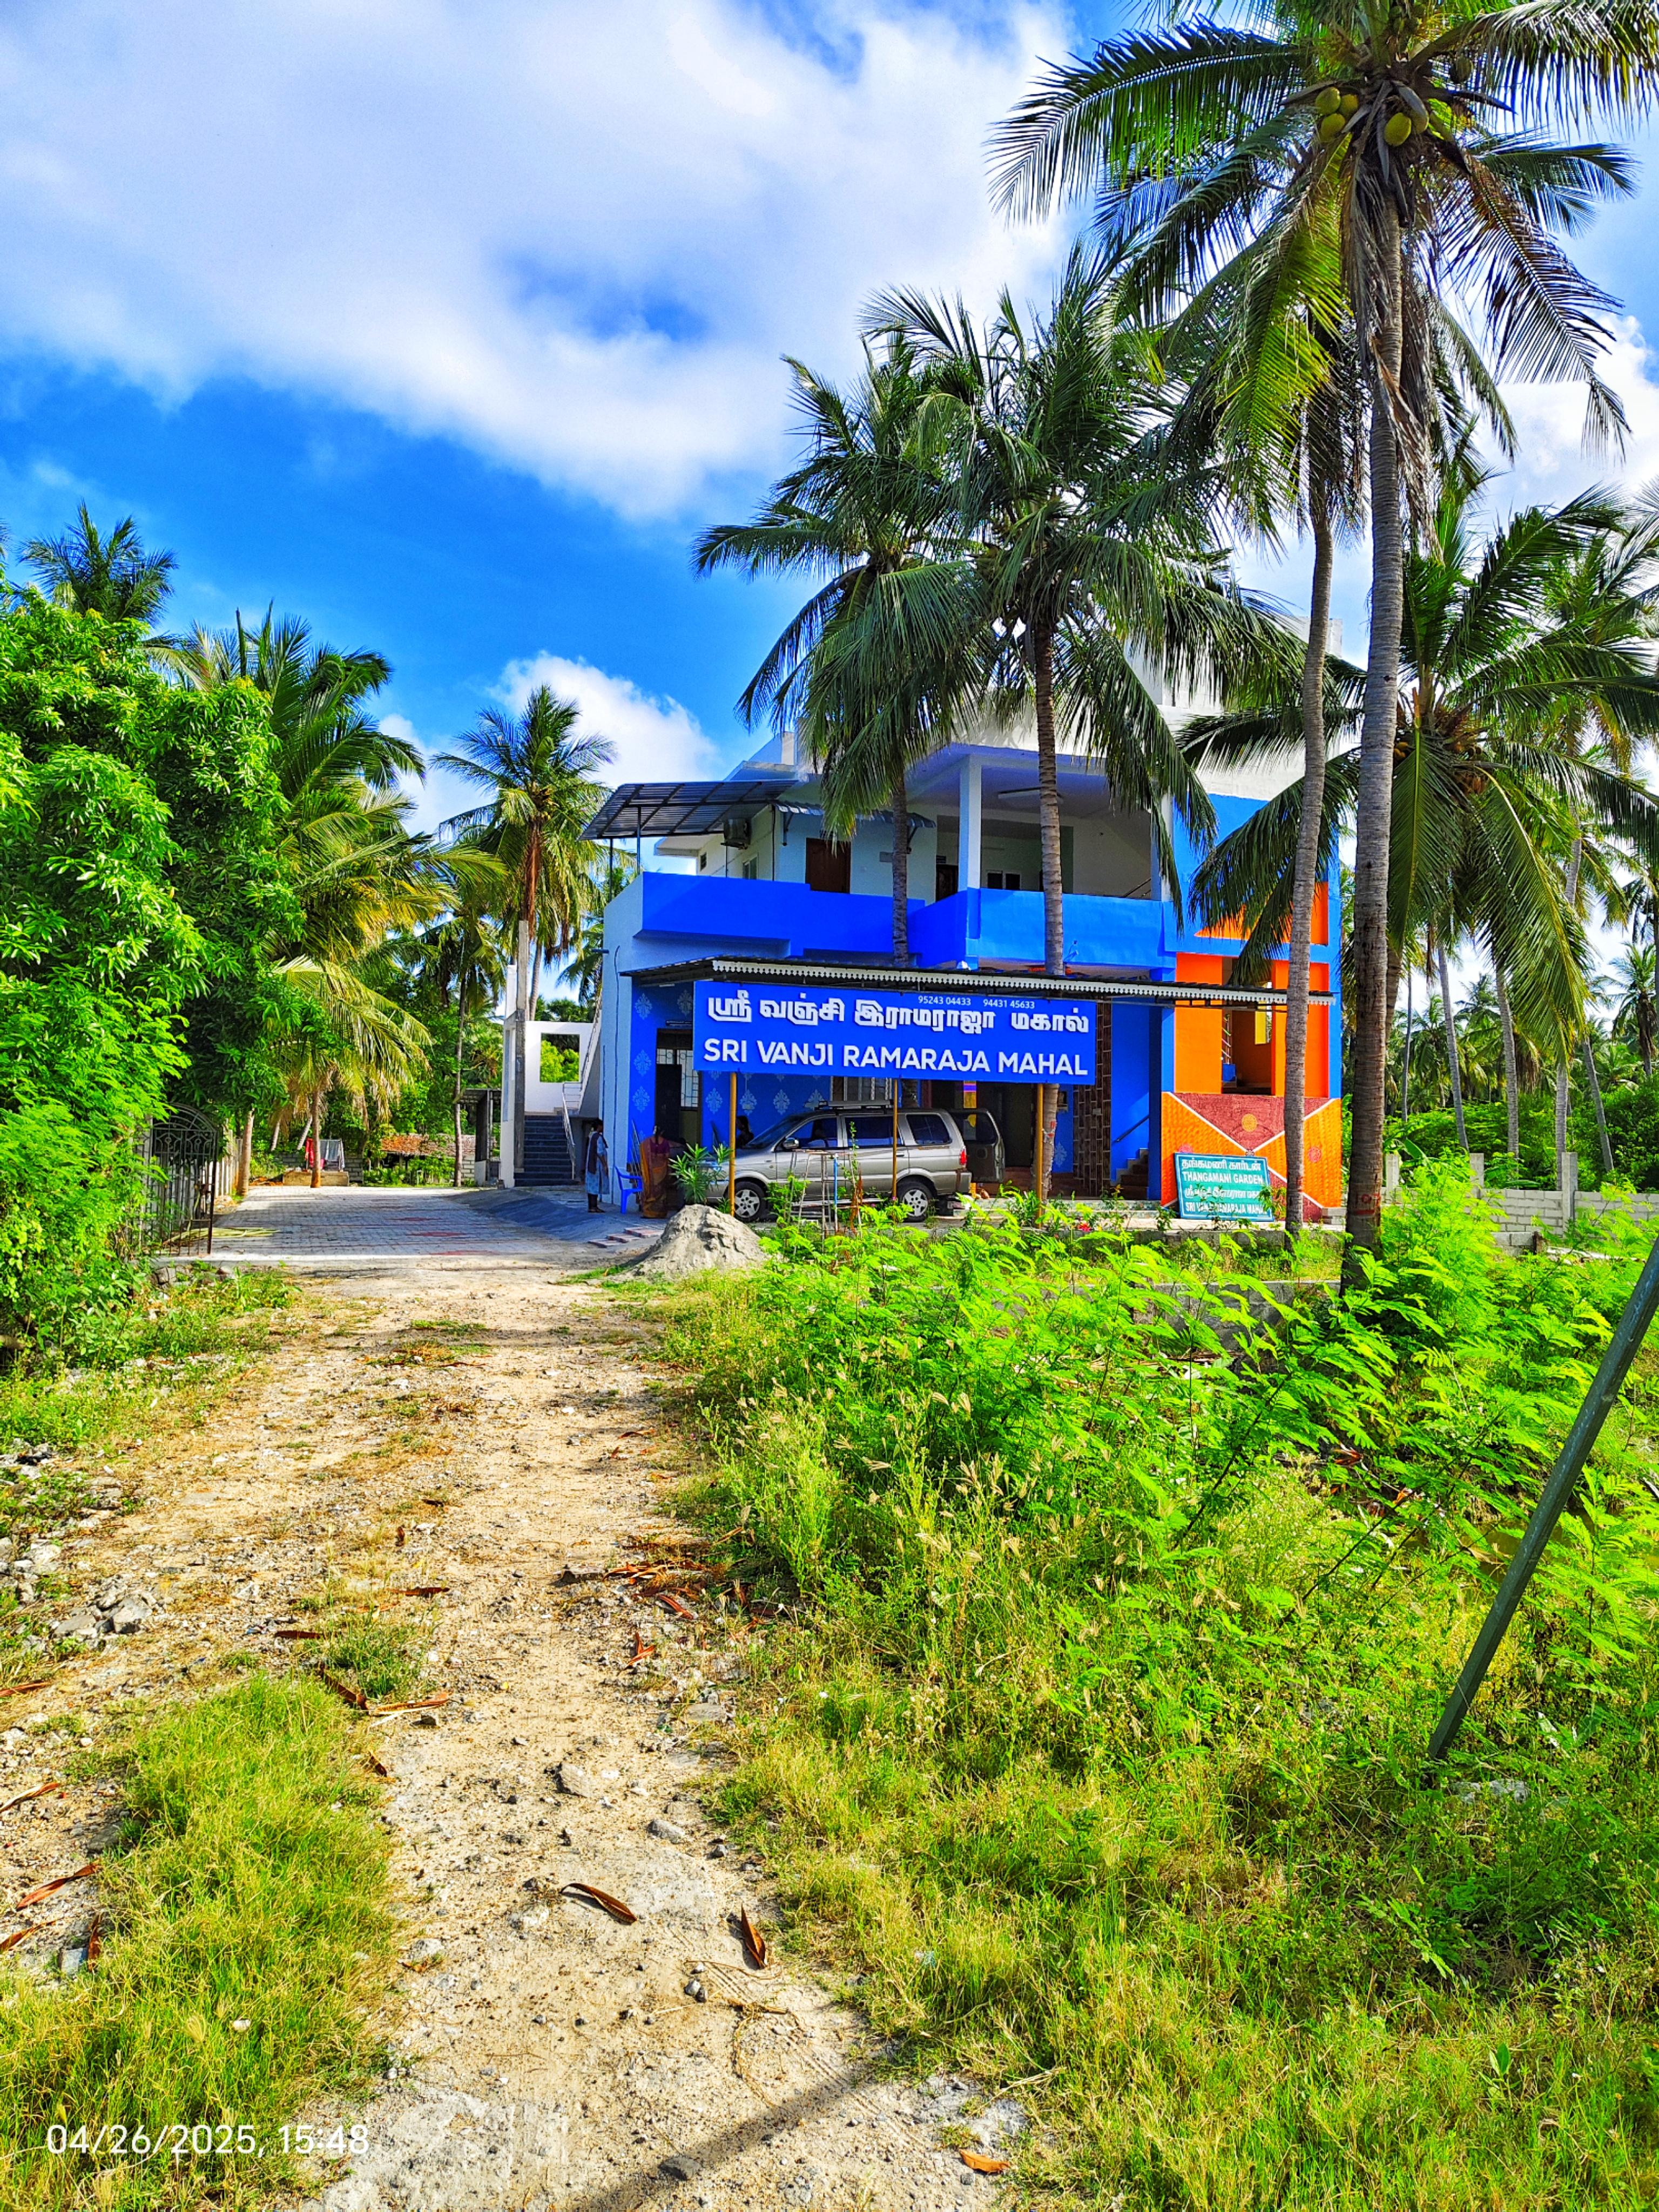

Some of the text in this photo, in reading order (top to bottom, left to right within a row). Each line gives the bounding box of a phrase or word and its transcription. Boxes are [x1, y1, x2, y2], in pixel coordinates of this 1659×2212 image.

[918, 996, 1035, 1009] 95243 04433 94431 45633
[759, 993, 845, 1026] வஞ்சி
[855, 999, 996, 1034] இராமராஜா
[1011, 1007, 1089, 1033] மகால்
[704, 1038, 1088, 1076] SRI VANJI RAMARAJA MAHAL
[1182, 1171, 1263, 1184] THANGAMANI GARDEN
[1185, 1202, 1196, 1212] SRI
